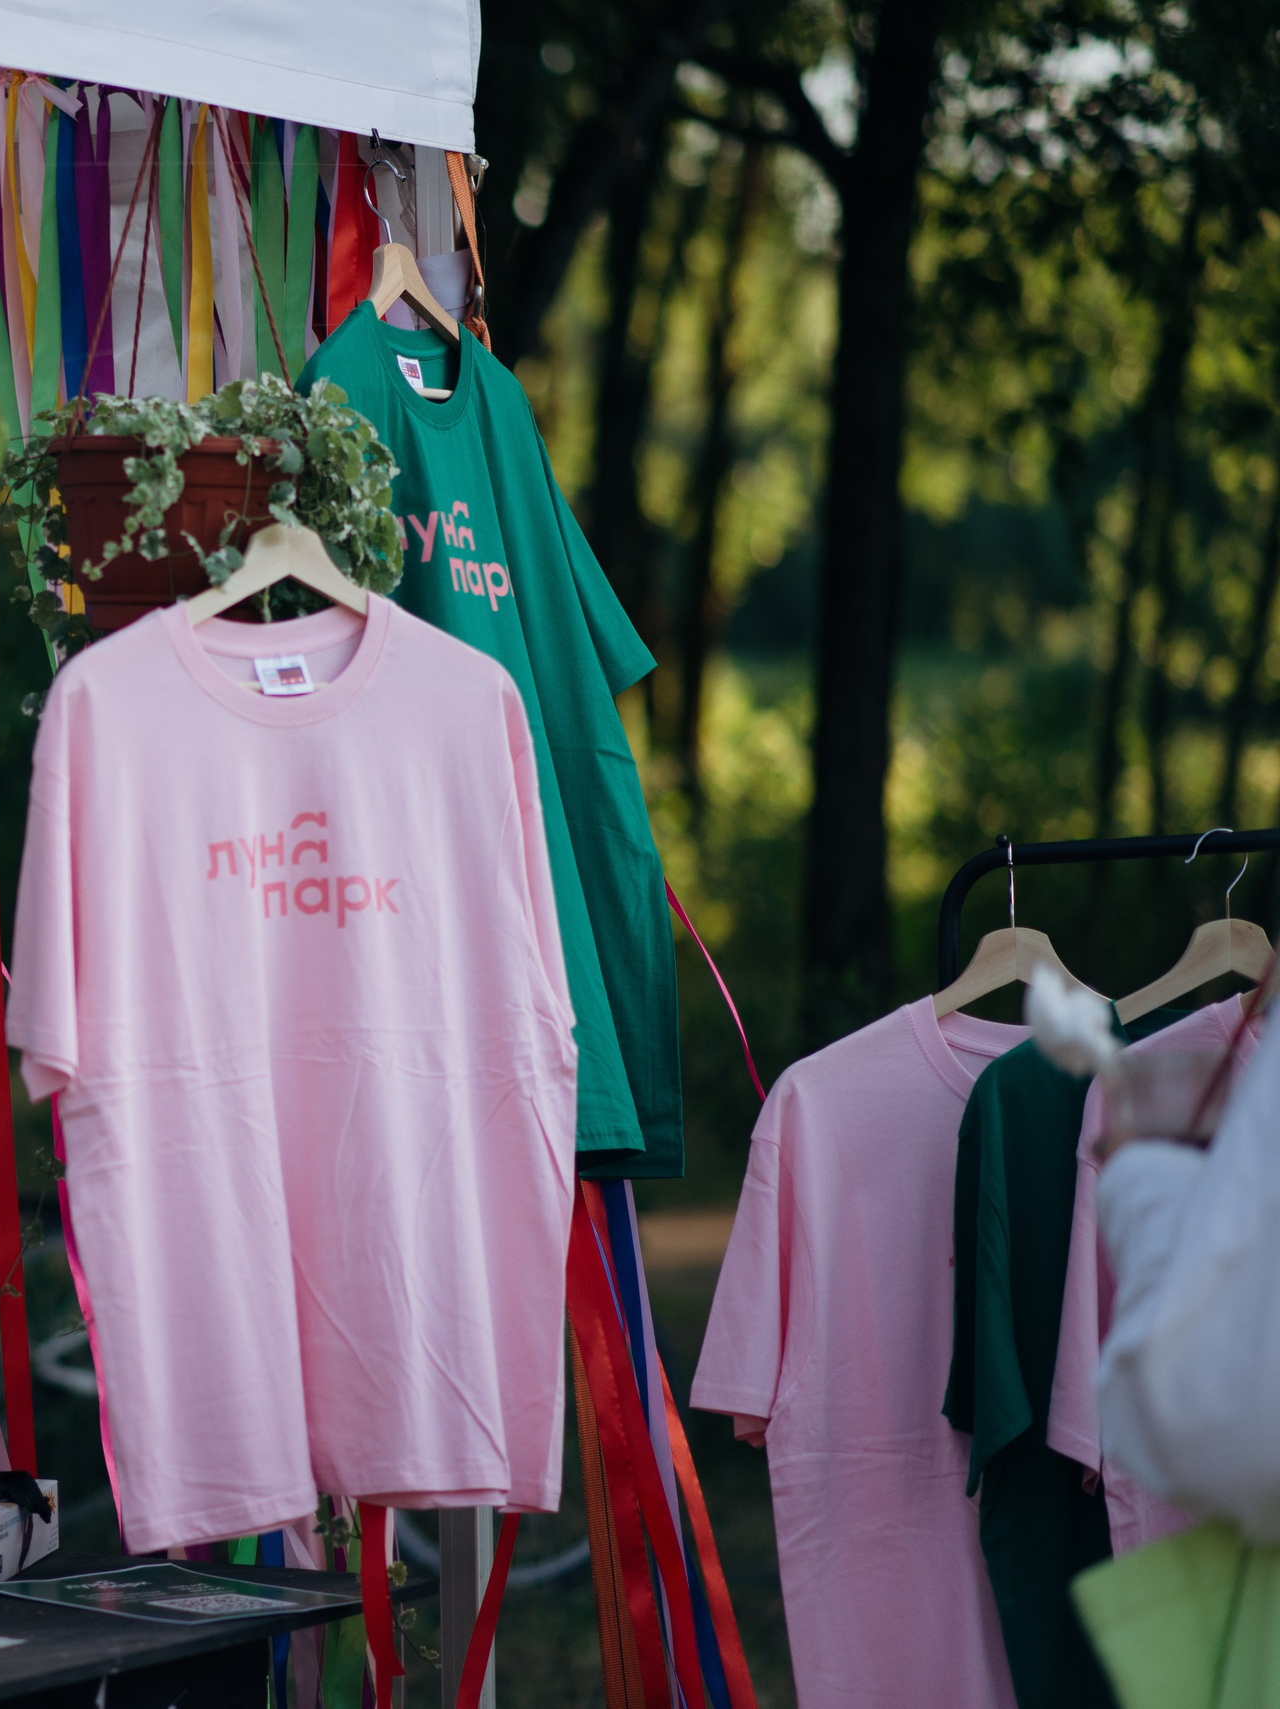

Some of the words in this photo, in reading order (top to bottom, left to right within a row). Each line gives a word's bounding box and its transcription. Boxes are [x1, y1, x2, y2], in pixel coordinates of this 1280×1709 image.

[449, 557, 515, 612] пар
[207, 811, 328, 889] луна
[262, 875, 400, 929] парк
